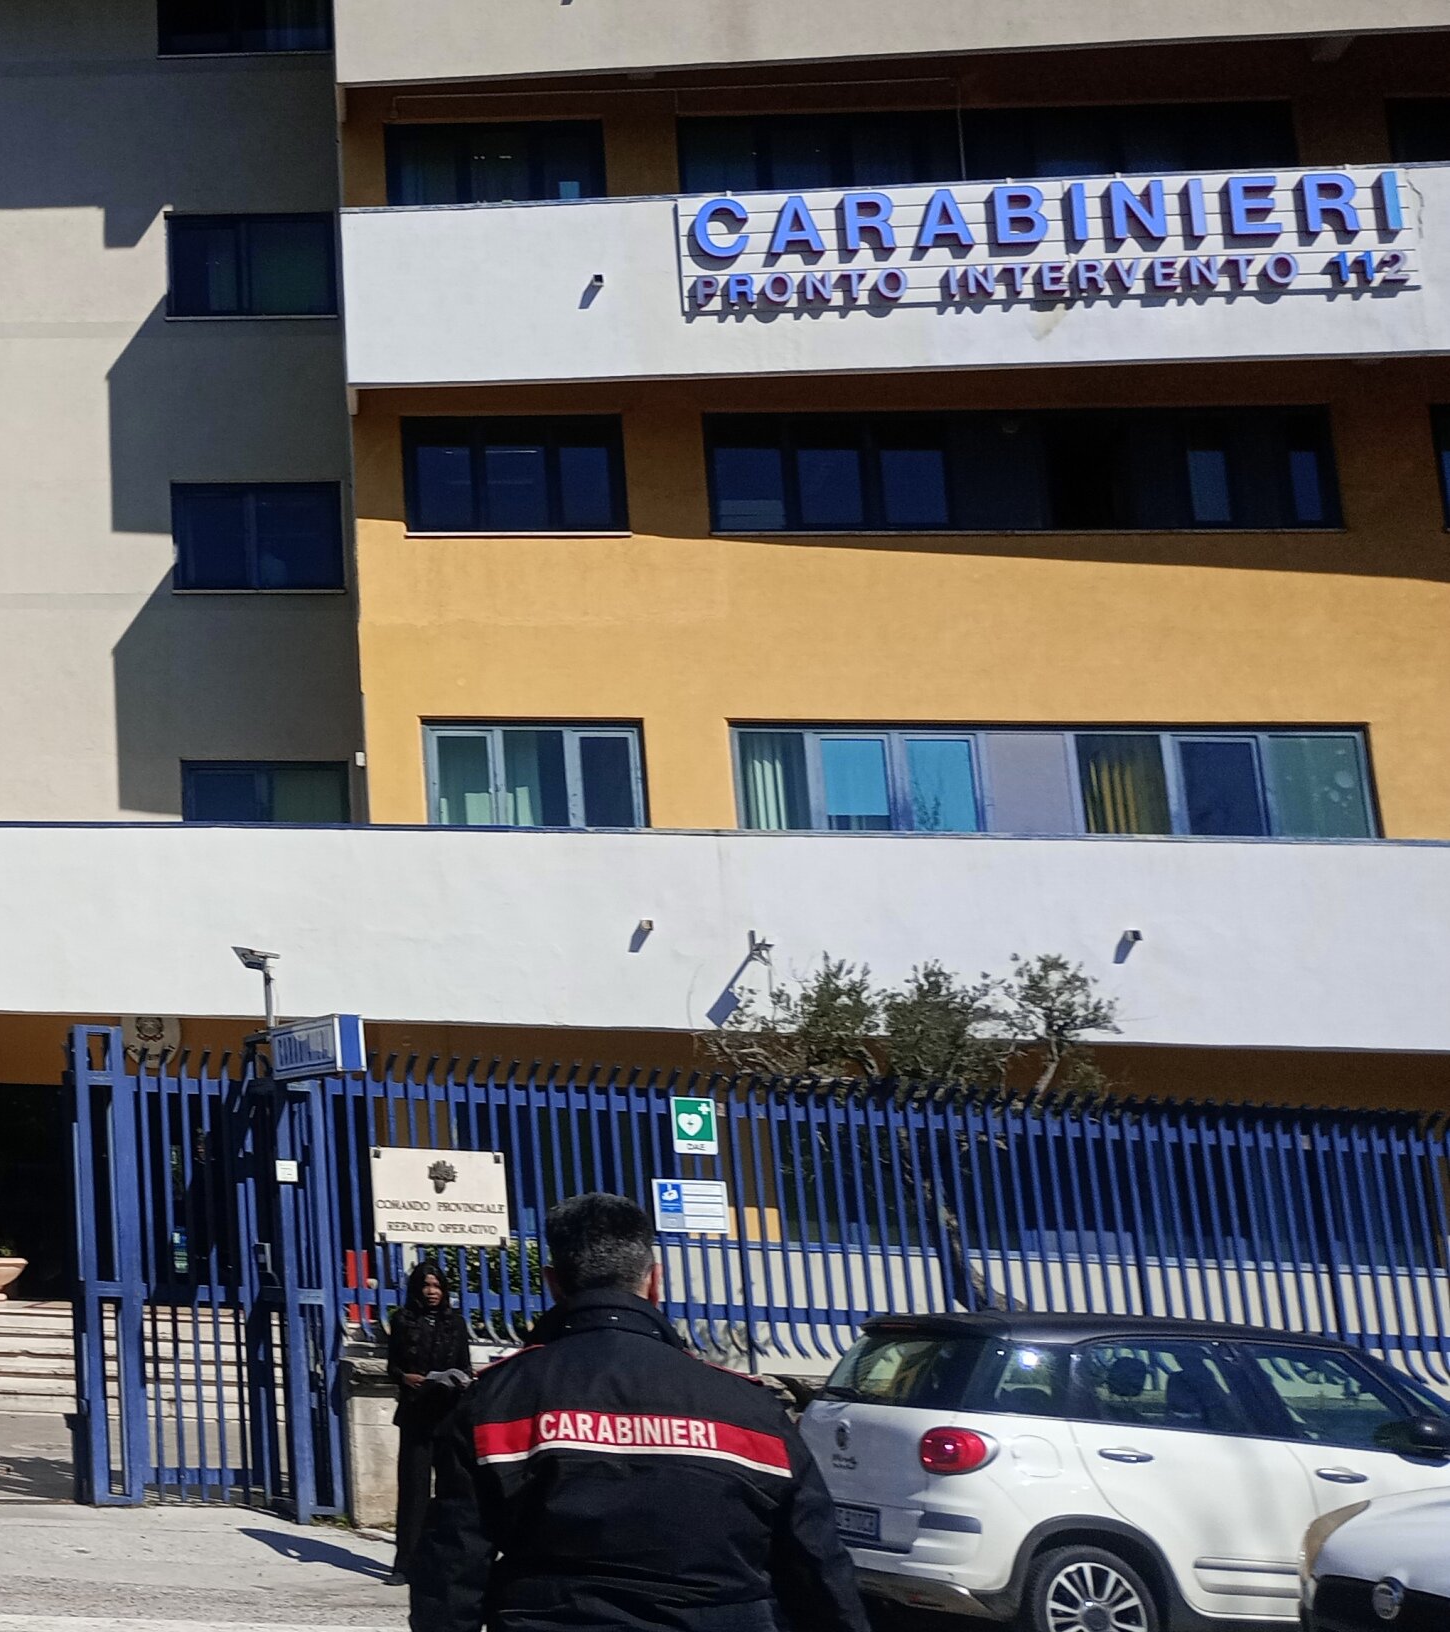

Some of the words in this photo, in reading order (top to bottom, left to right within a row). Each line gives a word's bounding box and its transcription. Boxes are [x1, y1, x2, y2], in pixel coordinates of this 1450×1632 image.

[693, 171, 1403, 258] CARABINIERI
[696, 267, 908, 306] PRONTO
[949, 251, 1298, 295] INTERVENTO
[1330, 250, 1410, 283] 112
[686, 1142, 707, 1151] DAE
[375, 1199, 431, 1211] COMANDO
[436, 1201, 506, 1214] PROVINCIALE
[386, 1221, 435, 1233] REPARTO
[438, 1223, 498, 1235] OPERATIVO
[538, 1412, 718, 1449] CARABINIERI
